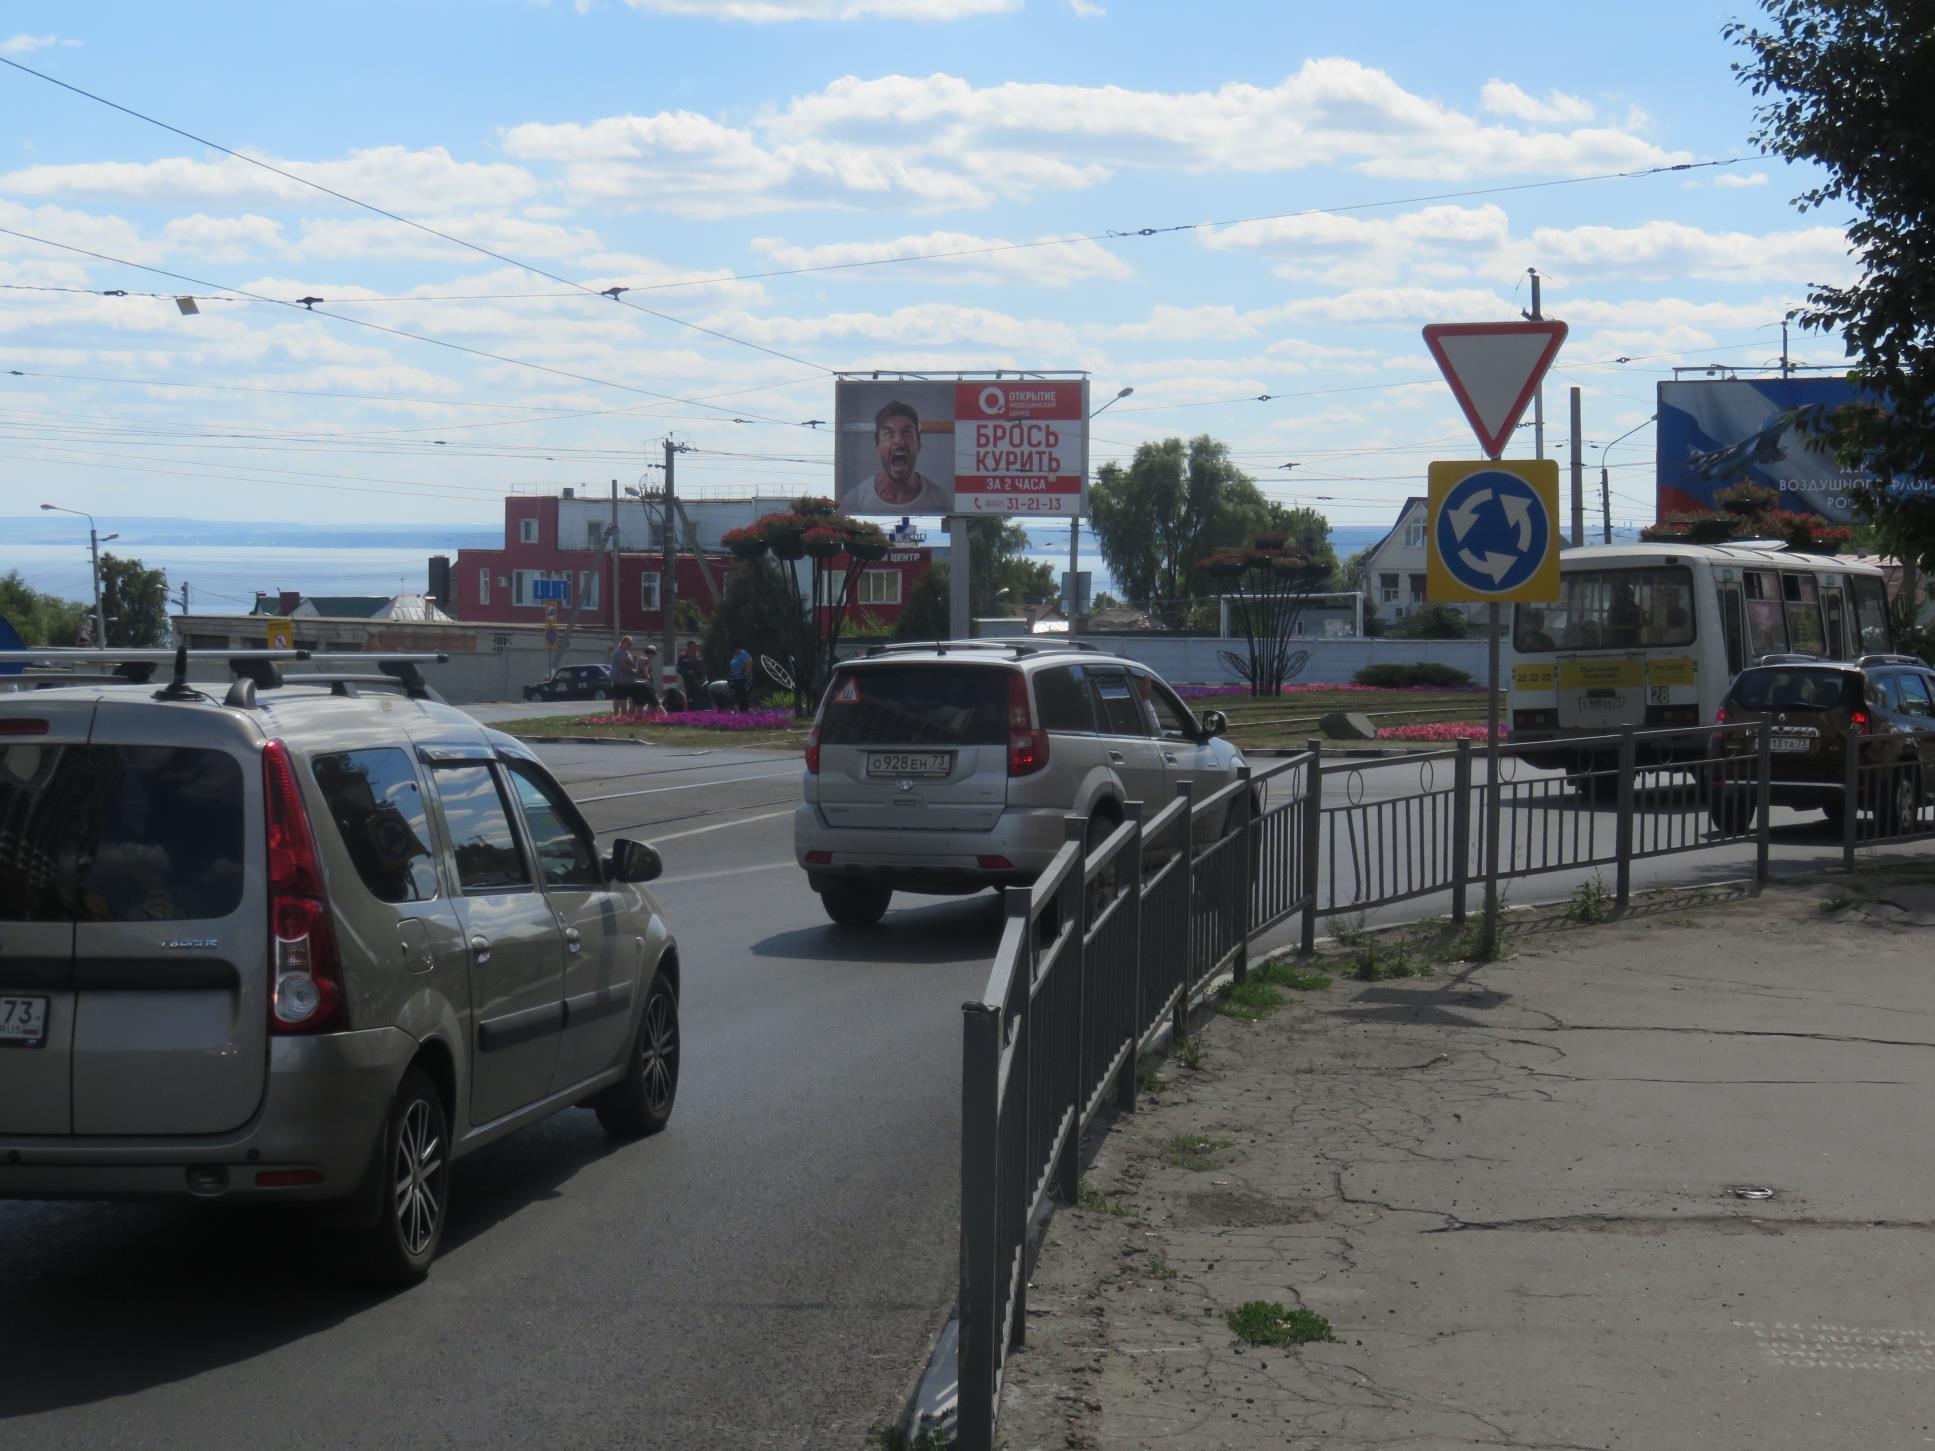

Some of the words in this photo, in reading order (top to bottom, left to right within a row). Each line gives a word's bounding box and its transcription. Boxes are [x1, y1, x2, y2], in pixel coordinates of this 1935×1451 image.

[1008, 391, 1057, 401] ОТКРЫТИЕ
[976, 423, 1059, 448] БРОСЬ
[976, 451, 1061, 472] КУРИТЬ
[986, 478, 1001, 490] ЗА
[1005, 479, 1012, 490] 2
[1015, 478, 1046, 490] ЧАСА
[1007, 498, 1061, 510] 31-21-13
[890, 553, 920, 562] ЦЕНТР
[1652, 687, 1669, 704] 28
[931, 755, 945, 766] 73
[4, 1001, 33, 1024] 73
